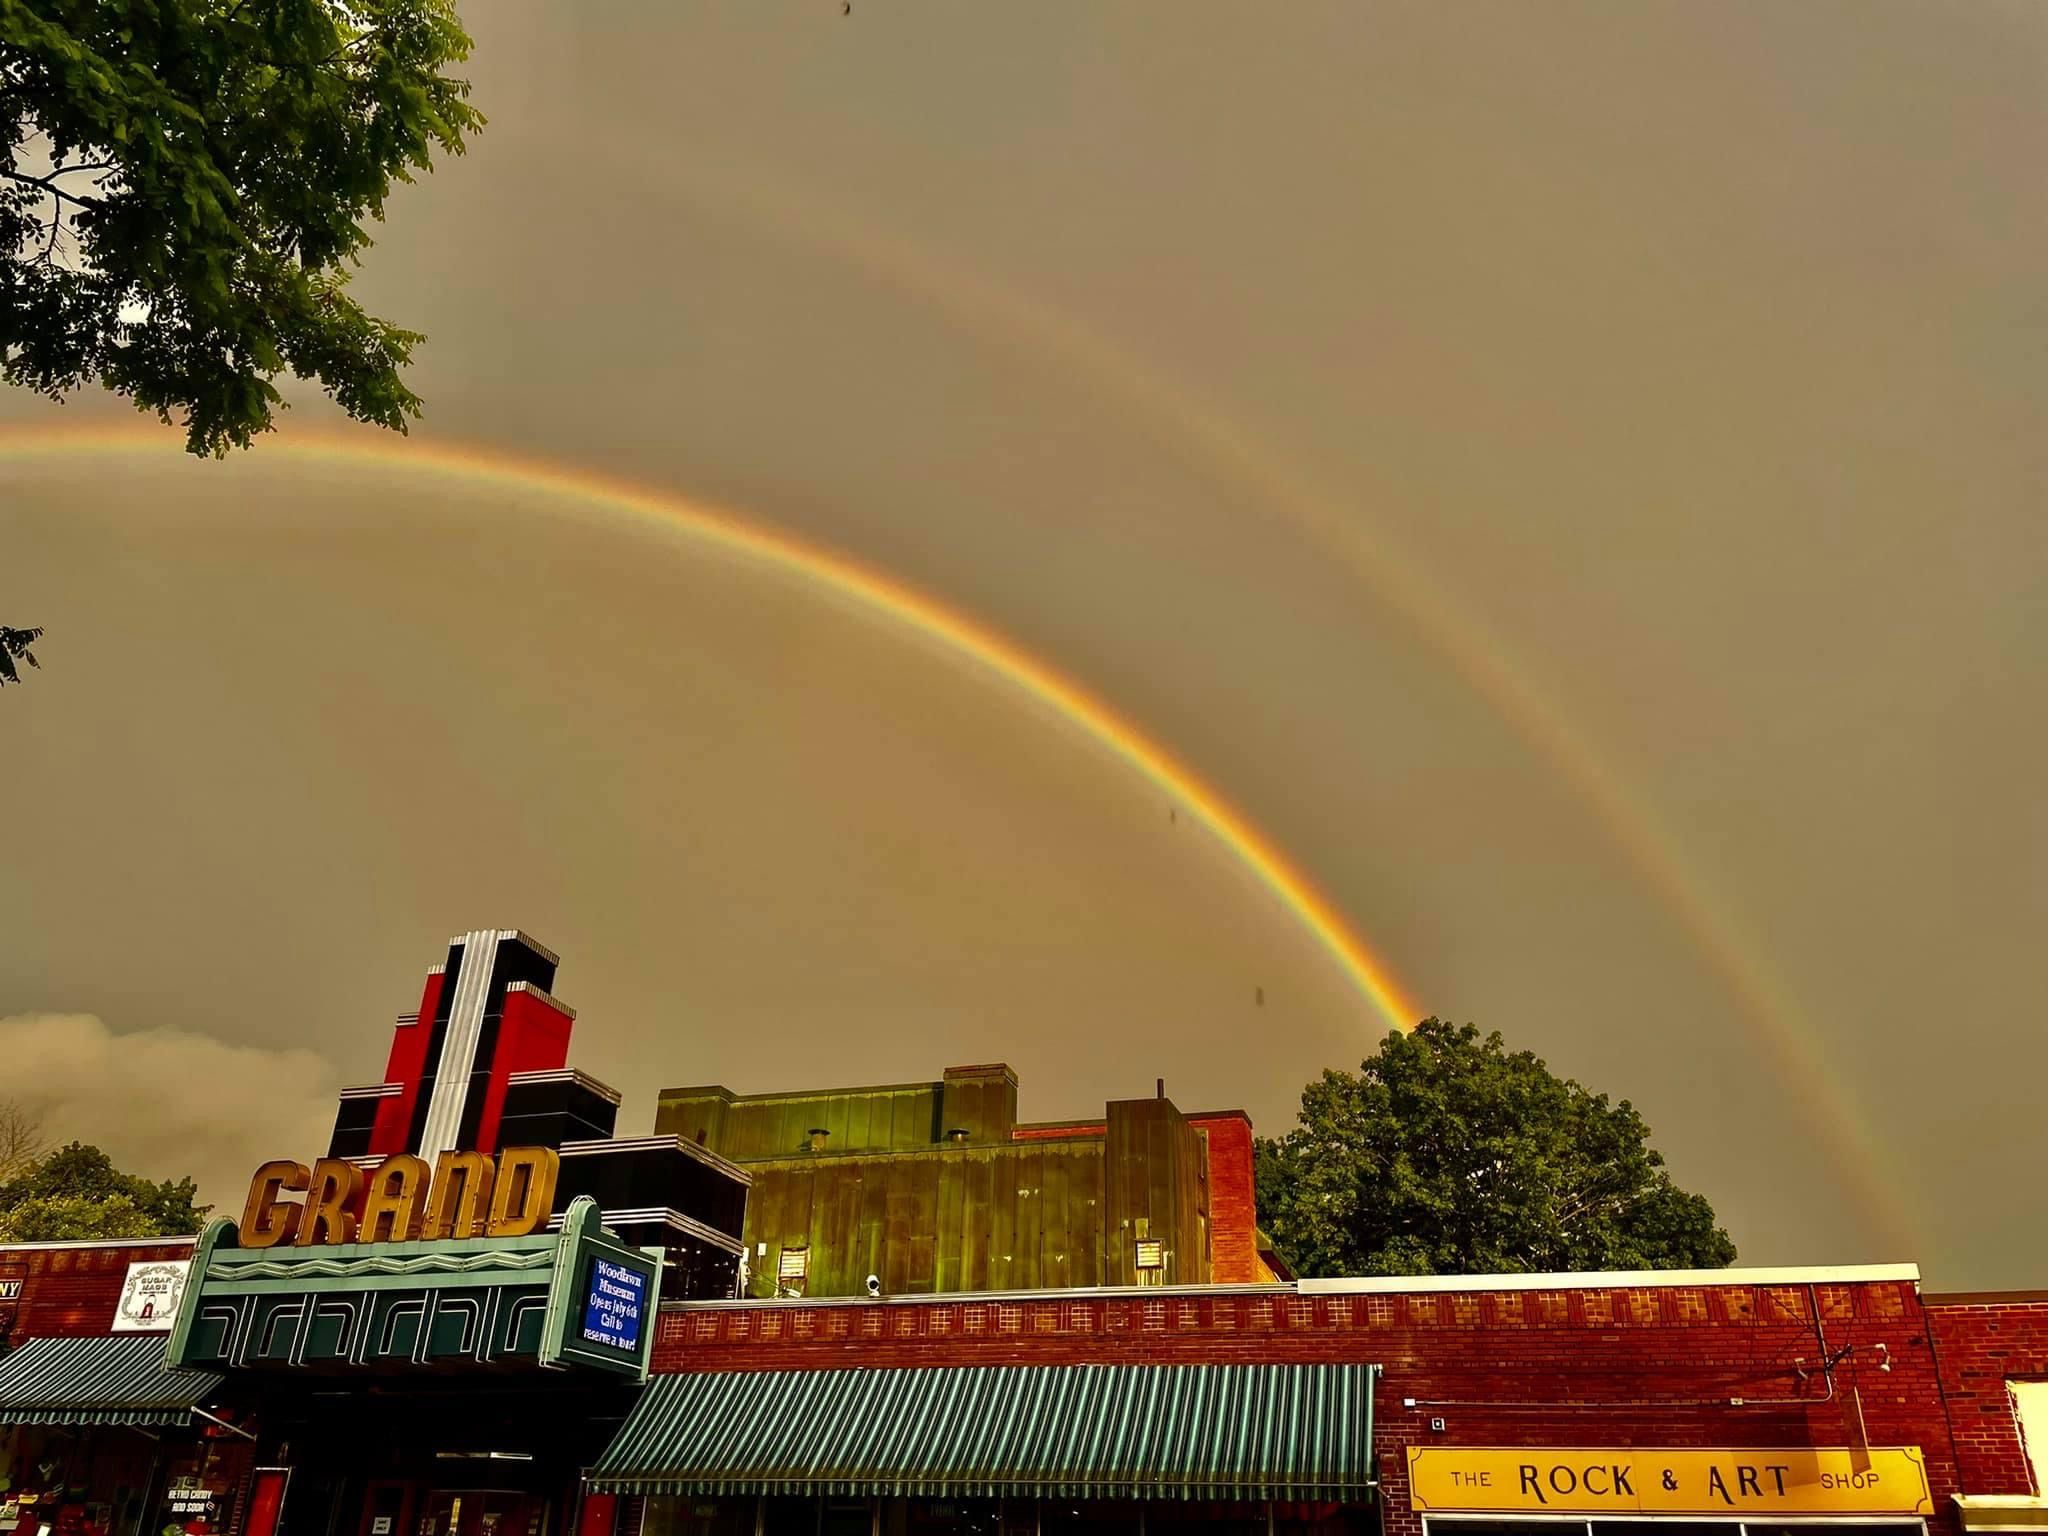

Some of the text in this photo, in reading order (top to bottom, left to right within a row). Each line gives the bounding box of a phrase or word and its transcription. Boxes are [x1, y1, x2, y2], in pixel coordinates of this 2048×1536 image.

[238, 1146, 560, 1248] GRAND
[598, 1261, 641, 1287] Woodlawn
[599, 1279, 635, 1301] Museum
[590, 1293, 637, 1318] Opens July 6th
[601, 1313, 623, 1330] Call to
[584, 1328, 611, 1344] reserve
[1450, 1464, 1880, 1505] THE ROCK & ART SHOP
